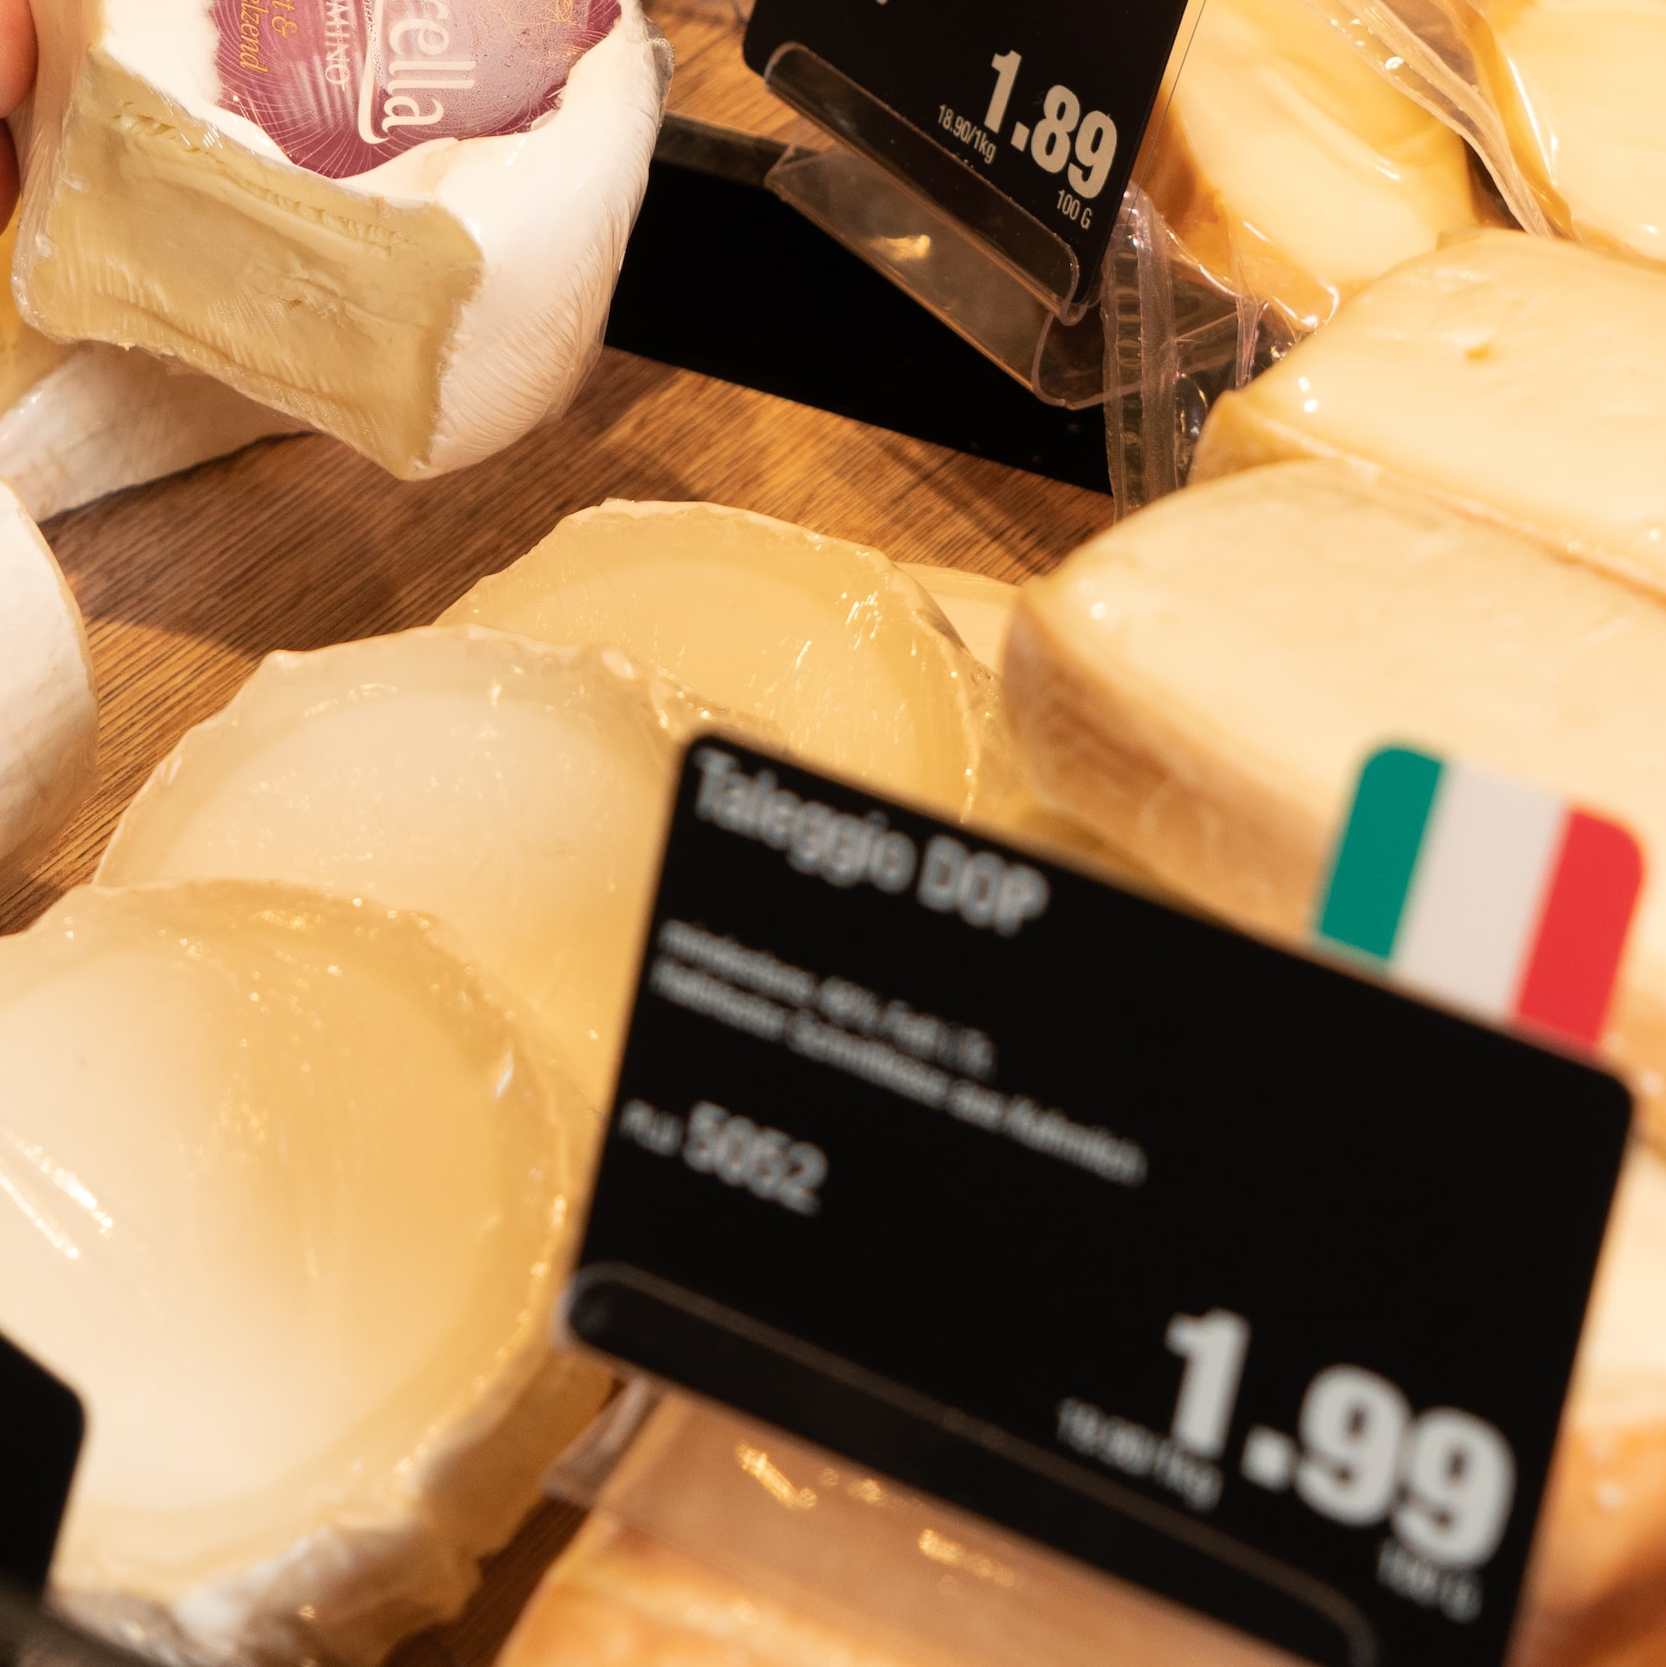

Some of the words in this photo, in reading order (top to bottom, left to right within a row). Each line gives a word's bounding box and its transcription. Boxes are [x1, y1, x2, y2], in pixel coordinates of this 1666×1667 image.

[271, 14, 298, 38] &
[938, 104, 997, 165] 18.90/1kg
[984, 49, 1118, 199] 1.89
[1057, 189, 1080, 220] 100
[1080, 207, 1092, 229] G
[693, 744, 918, 895] Taleggio
[916, 832, 1052, 938] DOP
[683, 1098, 830, 1218] 5052
[1164, 1306, 1519, 1570] 1.99
